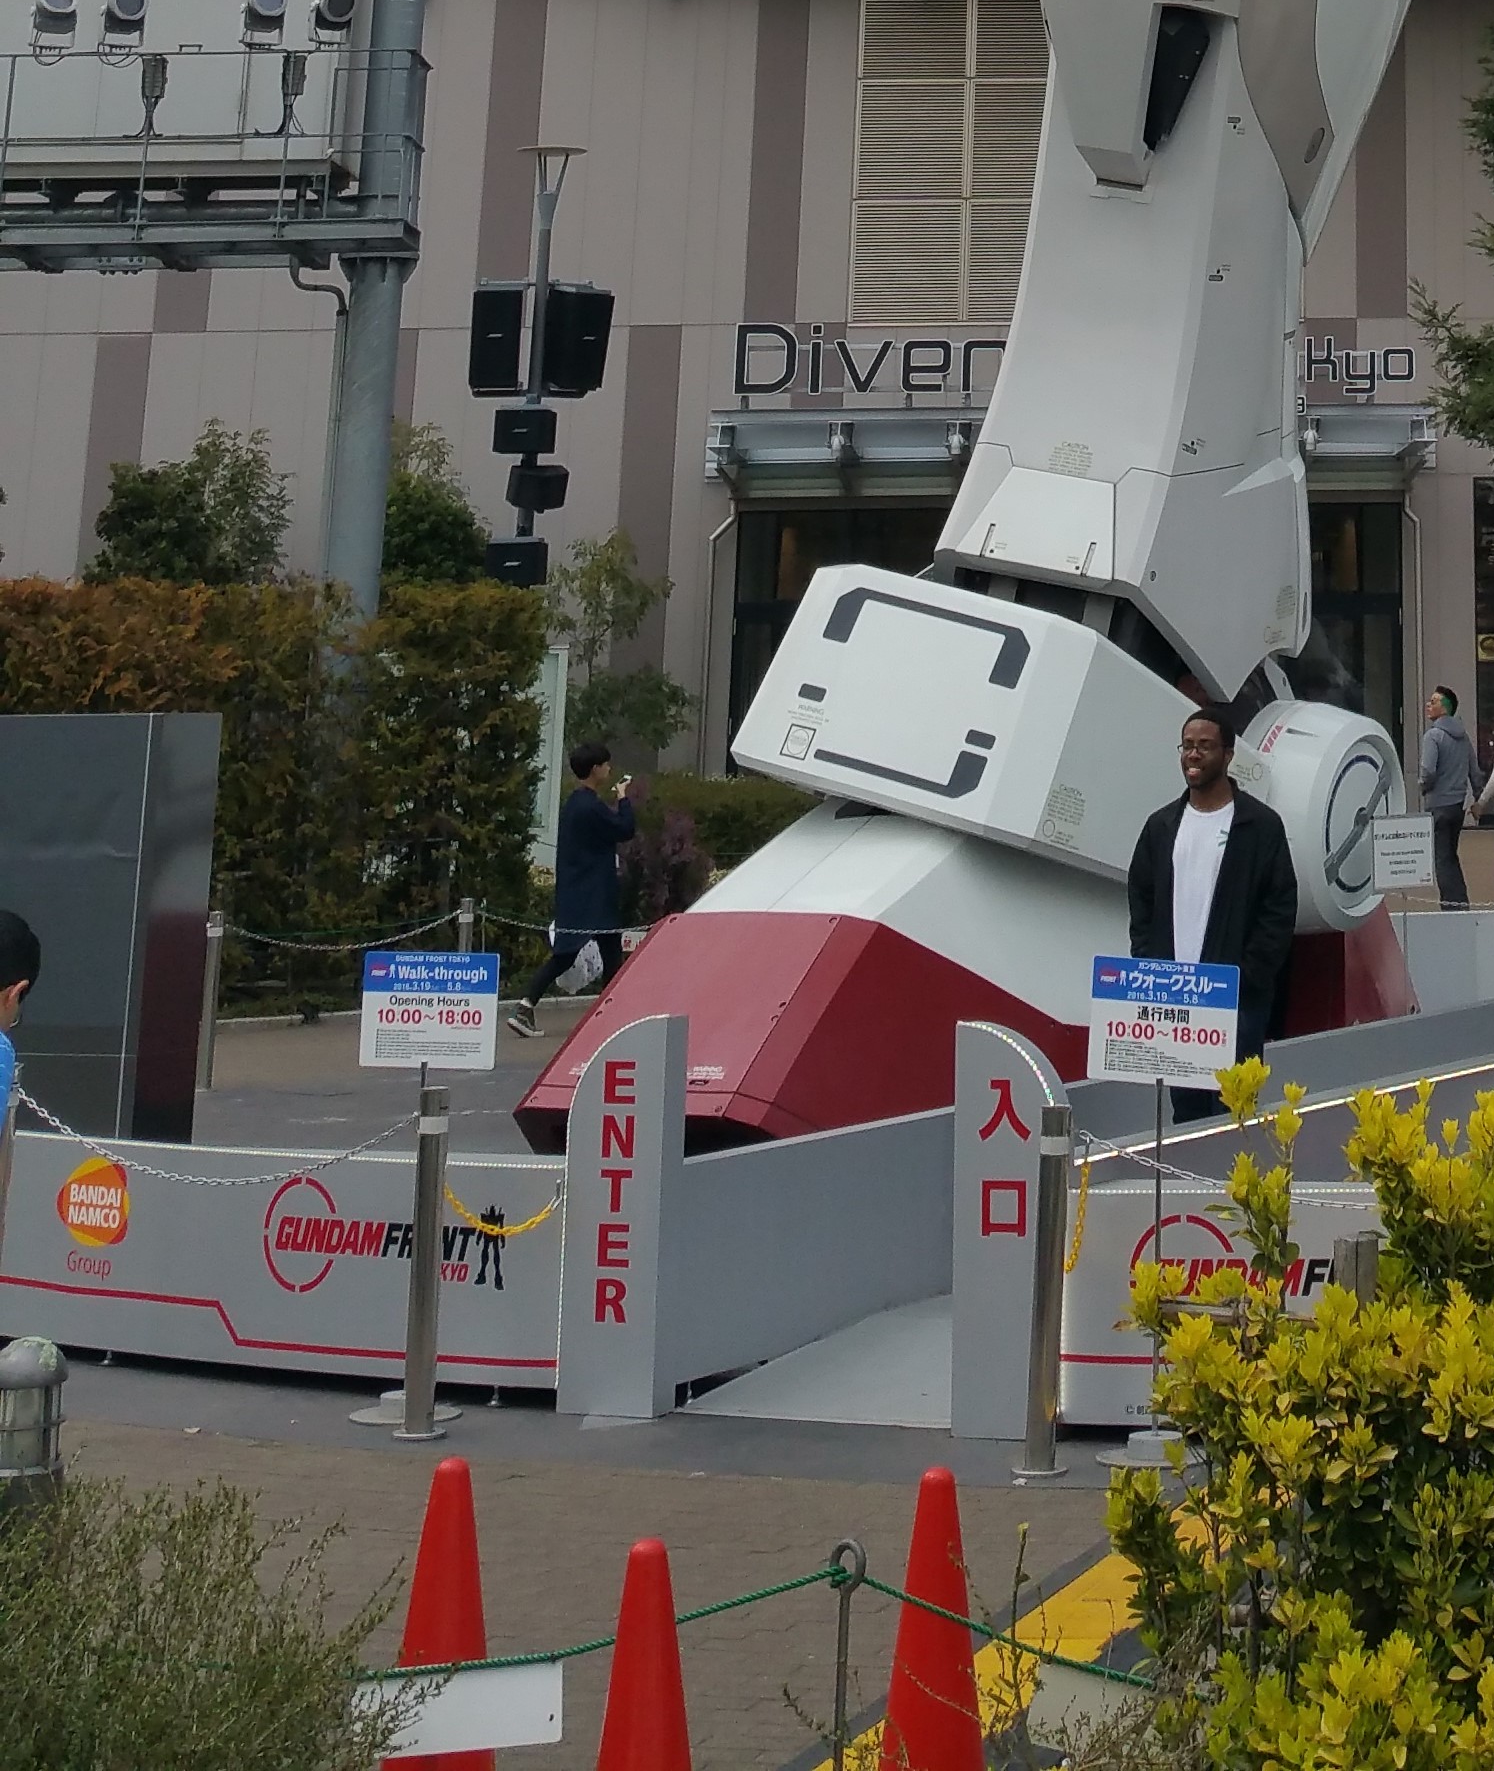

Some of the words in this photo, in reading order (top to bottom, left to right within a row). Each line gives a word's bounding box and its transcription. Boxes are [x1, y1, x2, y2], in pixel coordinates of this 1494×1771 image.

[733, 322, 1007, 396] Diver
[398, 965, 488, 984] Walk-through
[1128, 970, 1228, 994] ウォークスルー
[389, 994, 434, 1008] Opening
[437, 995, 471, 1007] Hours
[1136, 1005, 1190, 1025] 通行時間
[978, 1079, 1032, 1237] 入口
[69, 1183, 122, 1208] BANDAI
[594, 1061, 637, 1324] ENTER
[67, 1205, 121, 1228] NAMCO
[275, 1216, 477, 1262] GUNDAMFRNT
[66, 1249, 112, 1281] Group
